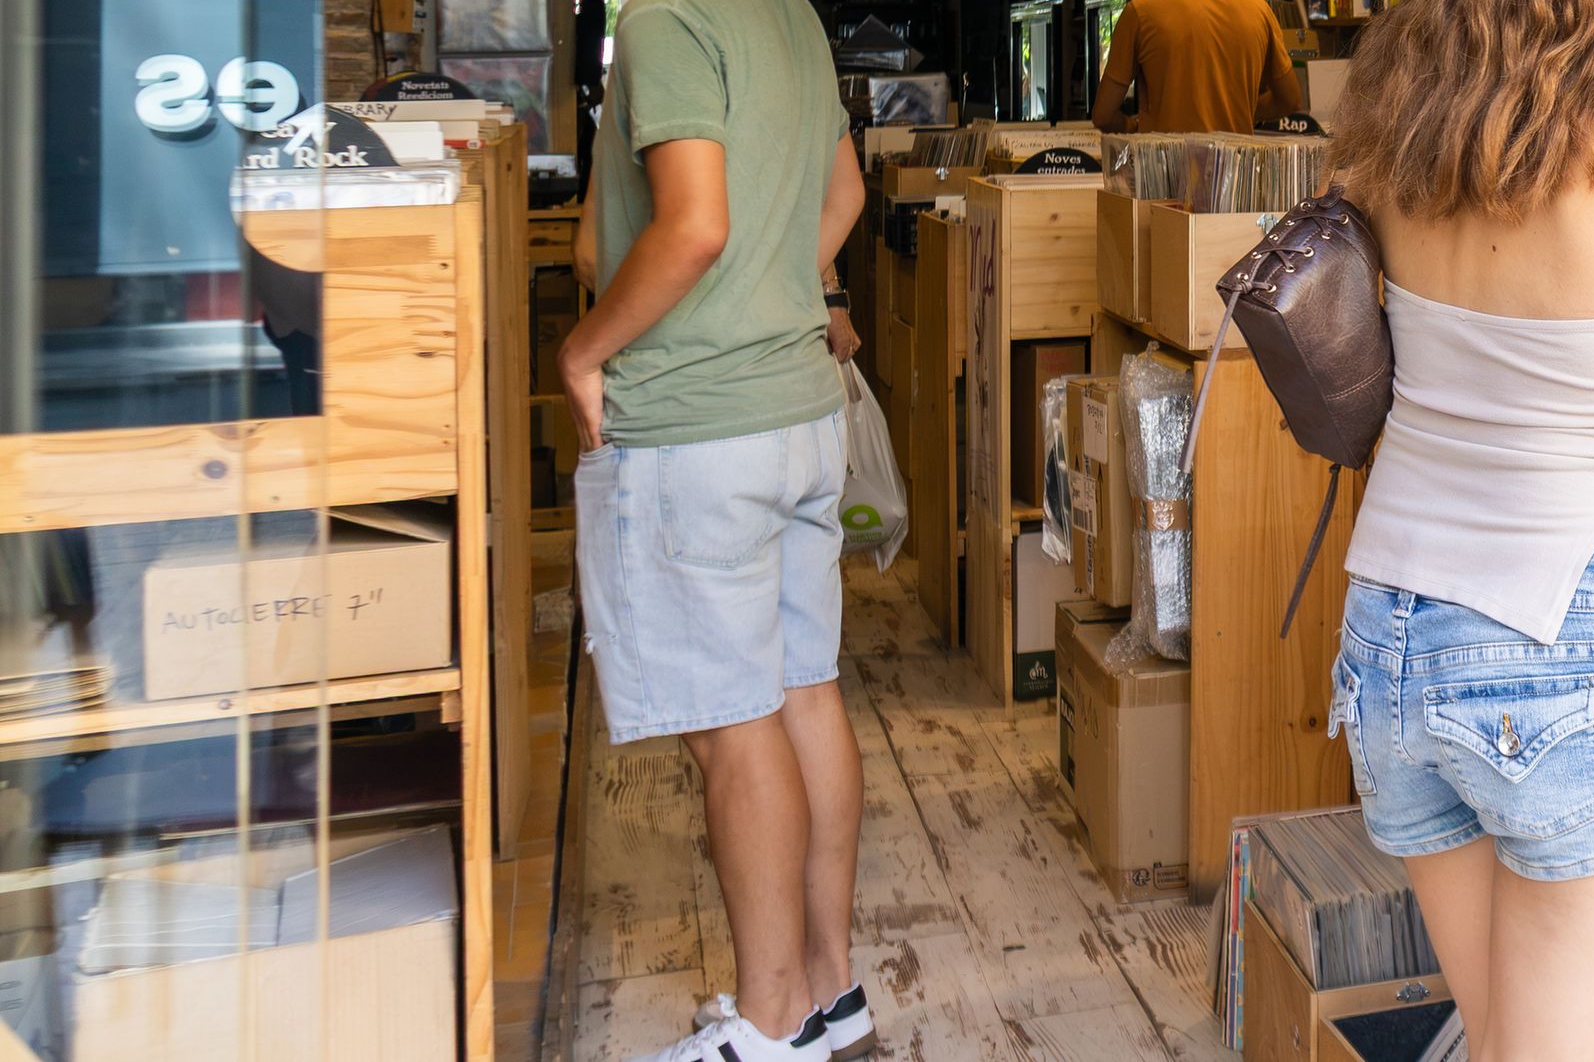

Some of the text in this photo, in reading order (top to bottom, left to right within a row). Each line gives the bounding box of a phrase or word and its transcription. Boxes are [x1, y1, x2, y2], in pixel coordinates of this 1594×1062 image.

[1278, 117, 1308, 134] Rap
[293, 145, 369, 168] Rock
[1044, 152, 1082, 165] Noves
